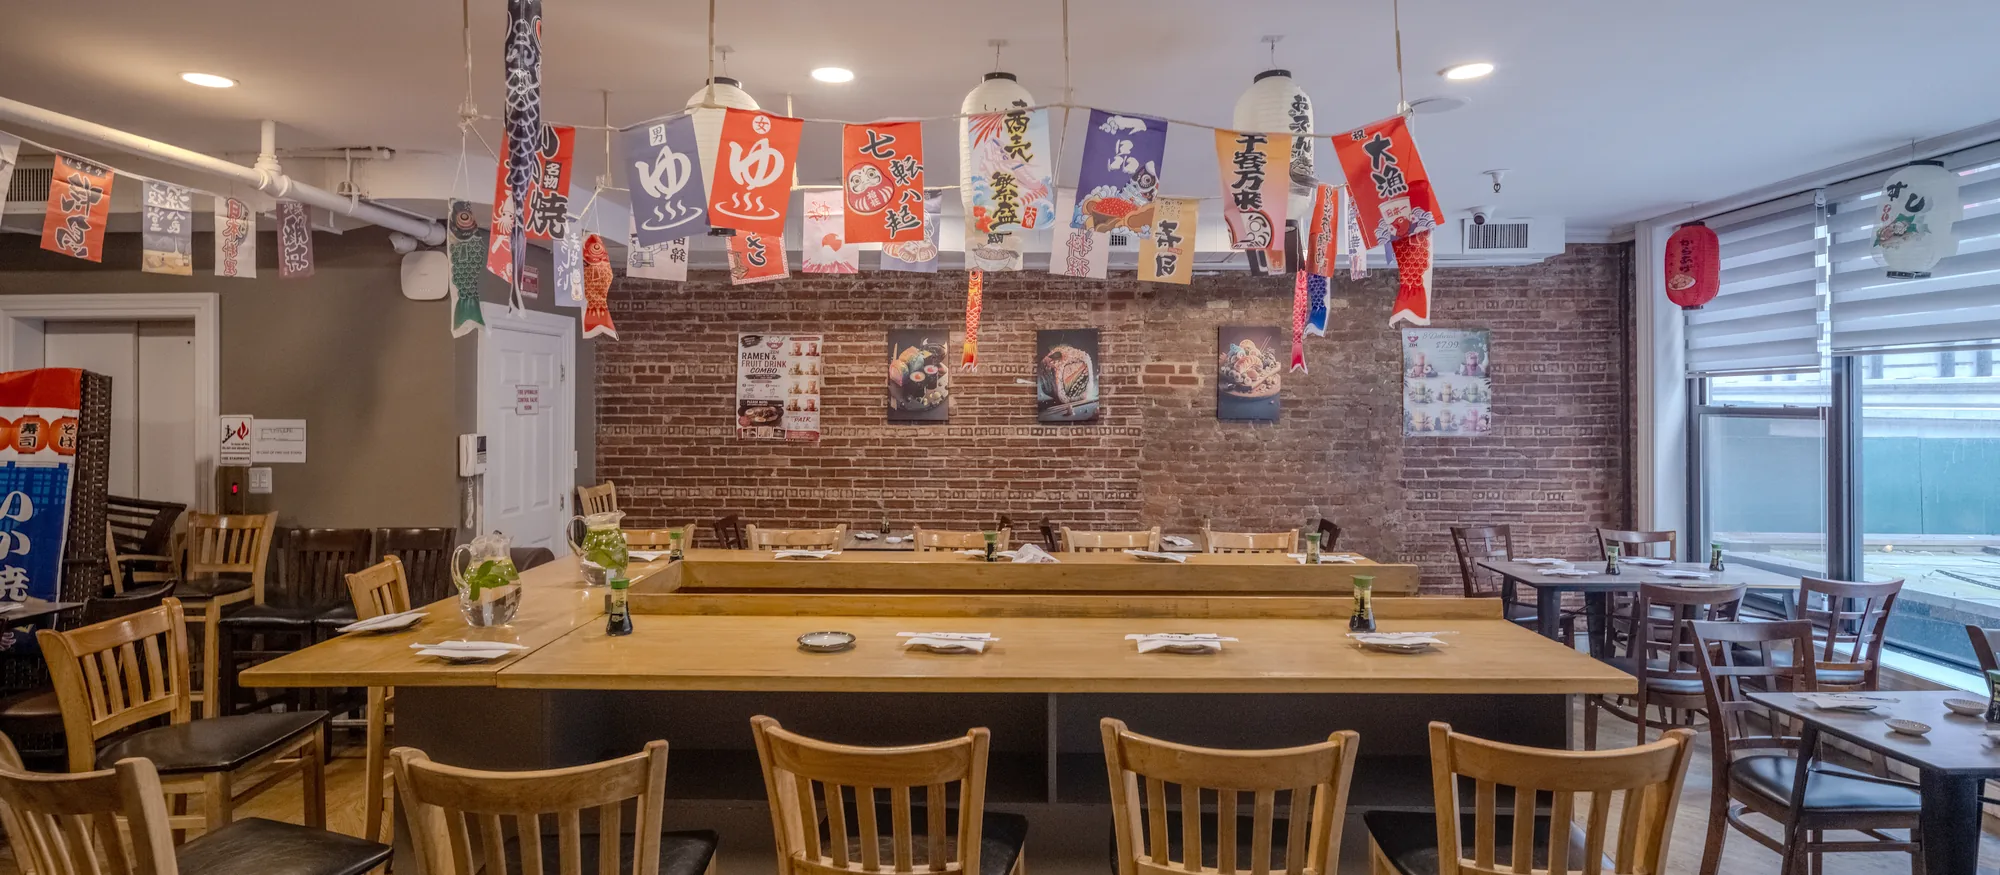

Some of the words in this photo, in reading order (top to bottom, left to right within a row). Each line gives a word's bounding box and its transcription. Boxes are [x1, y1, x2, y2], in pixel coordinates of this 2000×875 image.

[652, 126, 663, 143] 男
[754, 117, 769, 132] 女
[1352, 129, 1367, 141] 祝
[1099, 115, 1147, 172] 一品
[543, 162, 561, 190] 名物
[635, 145, 691, 200] ゆ
[729, 138, 785, 190] ゆ
[1362, 134, 1408, 198] 大漁
[1886, 181, 1926, 213] すし
[741, 352, 770, 360] RAMEN
[764, 360, 787, 368] DRINK
[19, 423, 39, 448] 寿司
[58, 424, 76, 448] そば
